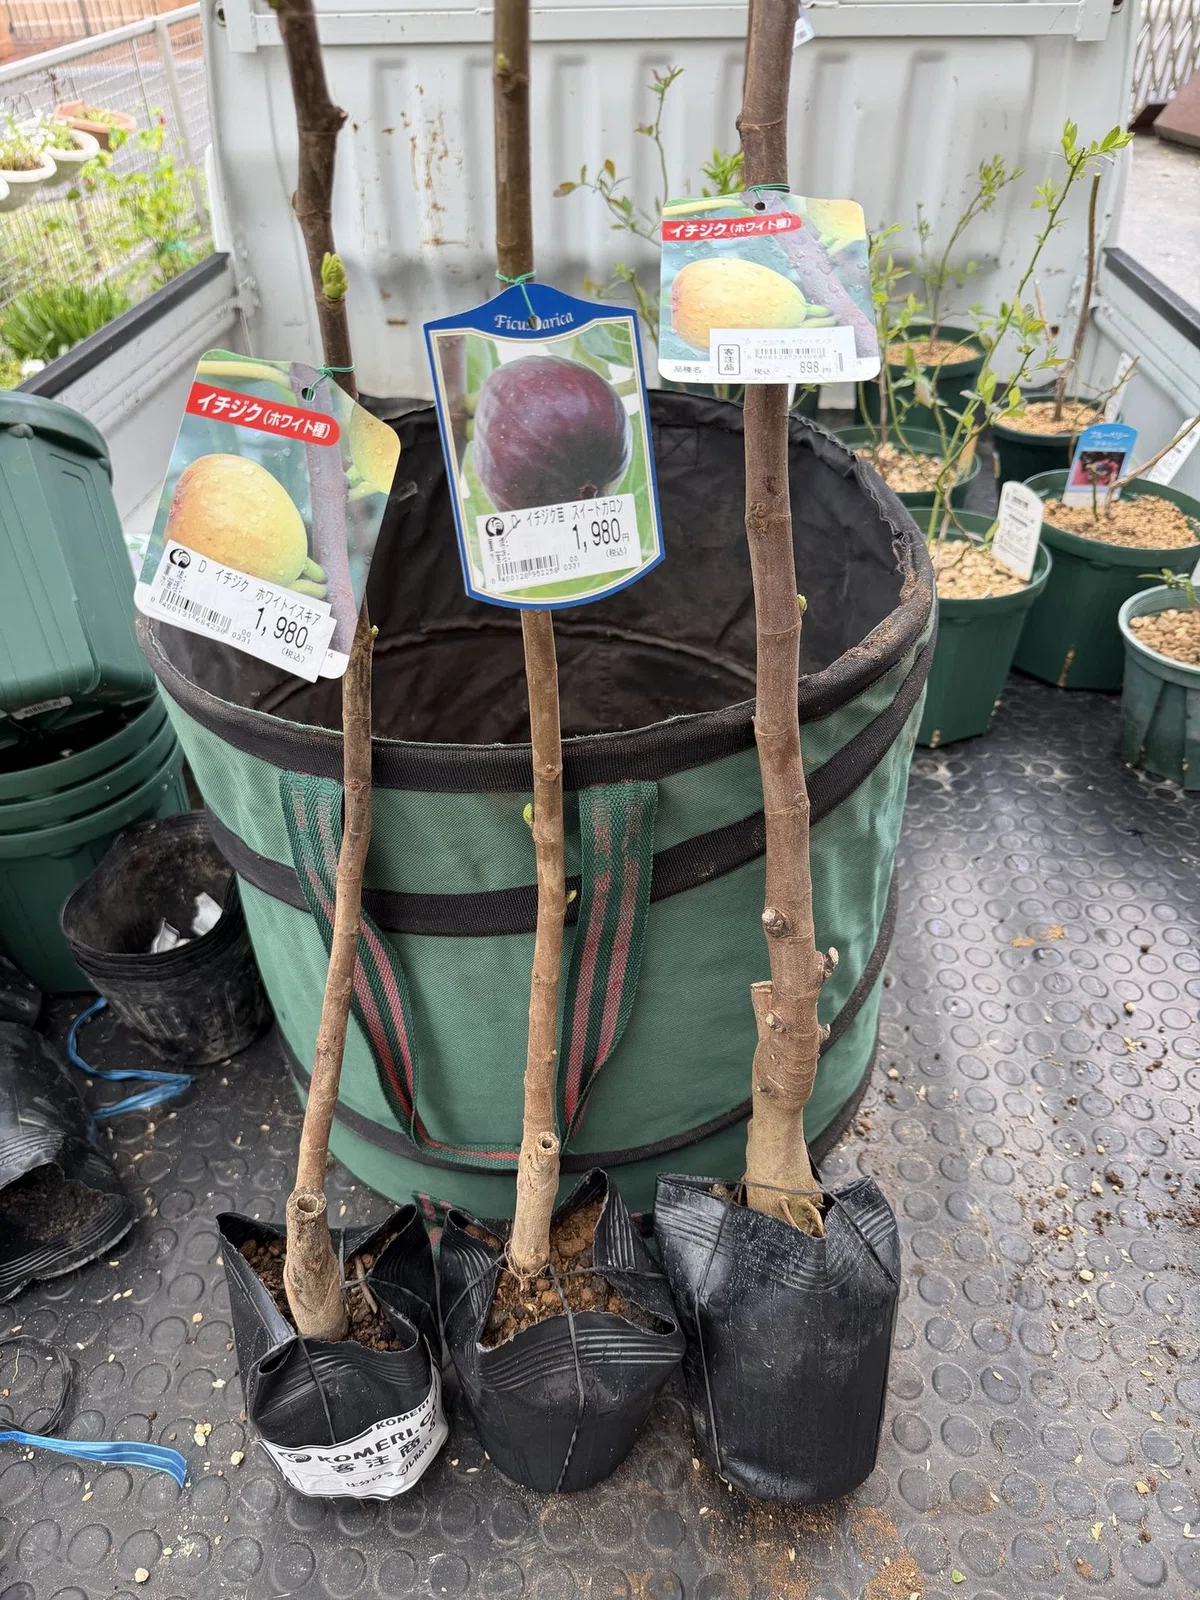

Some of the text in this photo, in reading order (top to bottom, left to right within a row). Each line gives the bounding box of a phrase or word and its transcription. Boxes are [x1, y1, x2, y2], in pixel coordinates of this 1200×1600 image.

[538, 311, 574, 330] arica
[674, 365, 702, 374] 品種名
[572, 498, 624, 521] スイートカロン
[215, 568, 249, 593] イチジク
[255, 587, 322, 626] ホワイトイスキア
